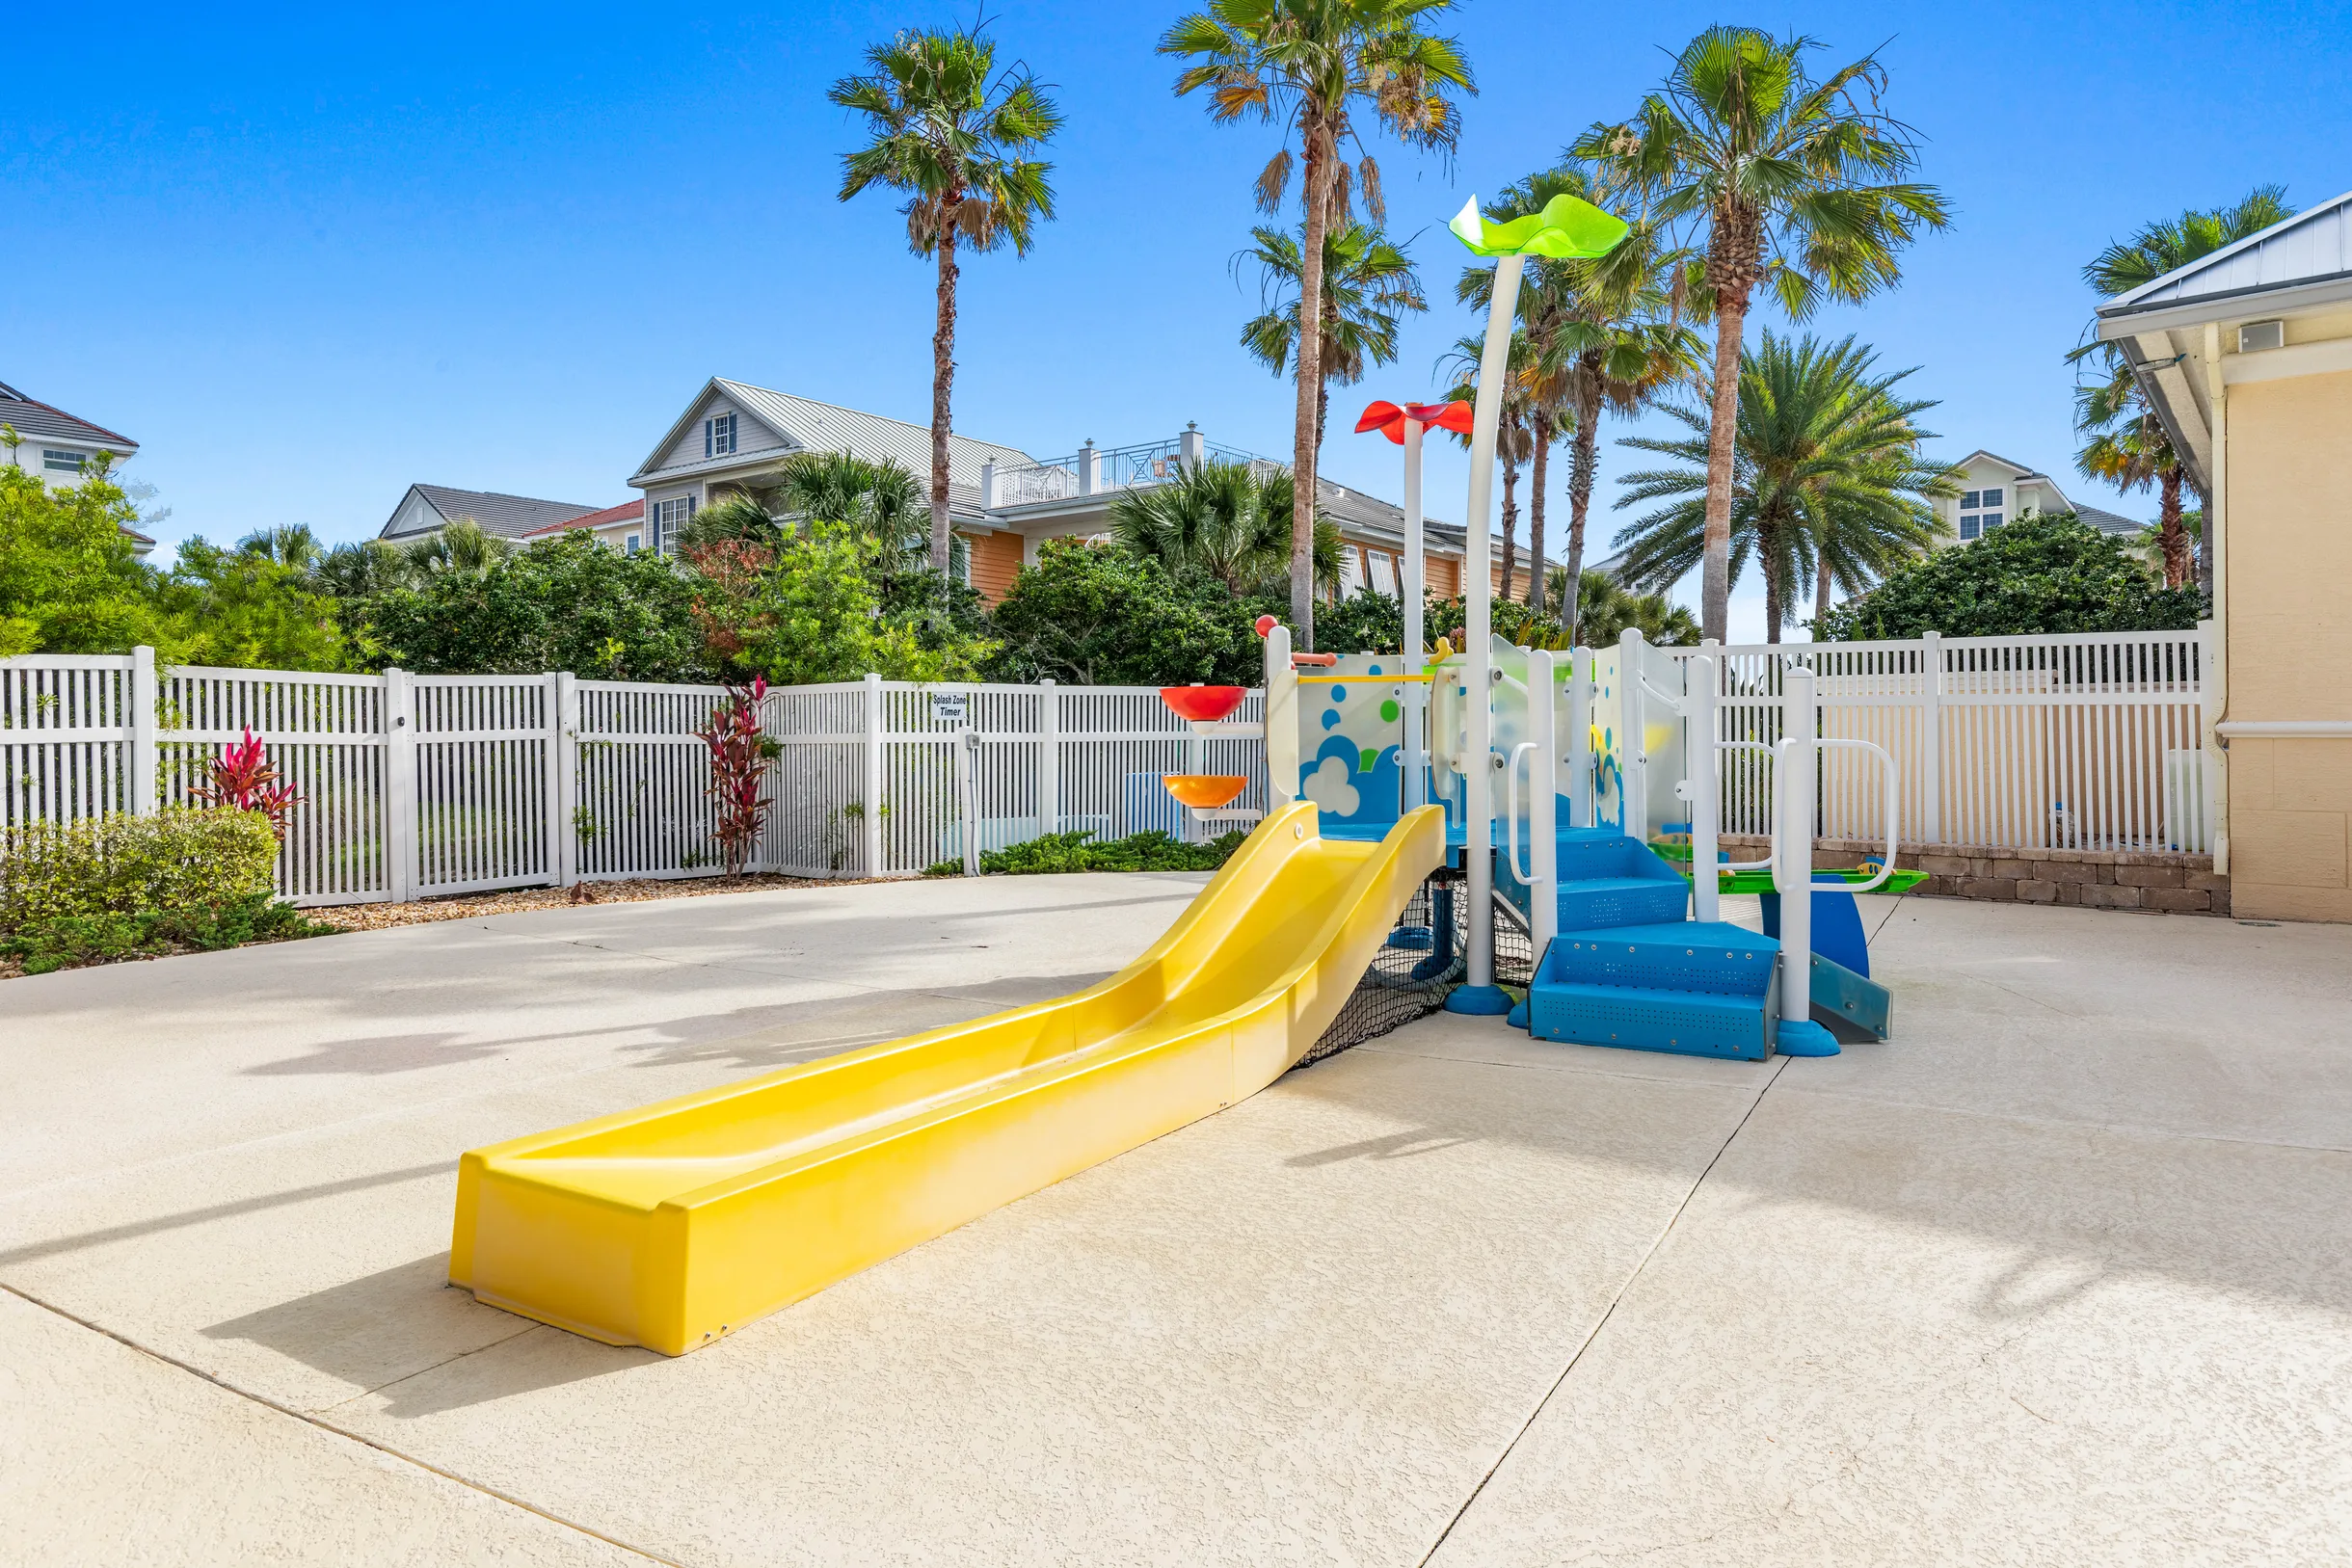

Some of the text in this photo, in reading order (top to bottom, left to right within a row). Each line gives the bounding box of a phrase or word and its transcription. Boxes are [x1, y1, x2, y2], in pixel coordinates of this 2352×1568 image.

[933, 695, 966, 706] Splash Zone
[940, 706, 961, 716] Timer
